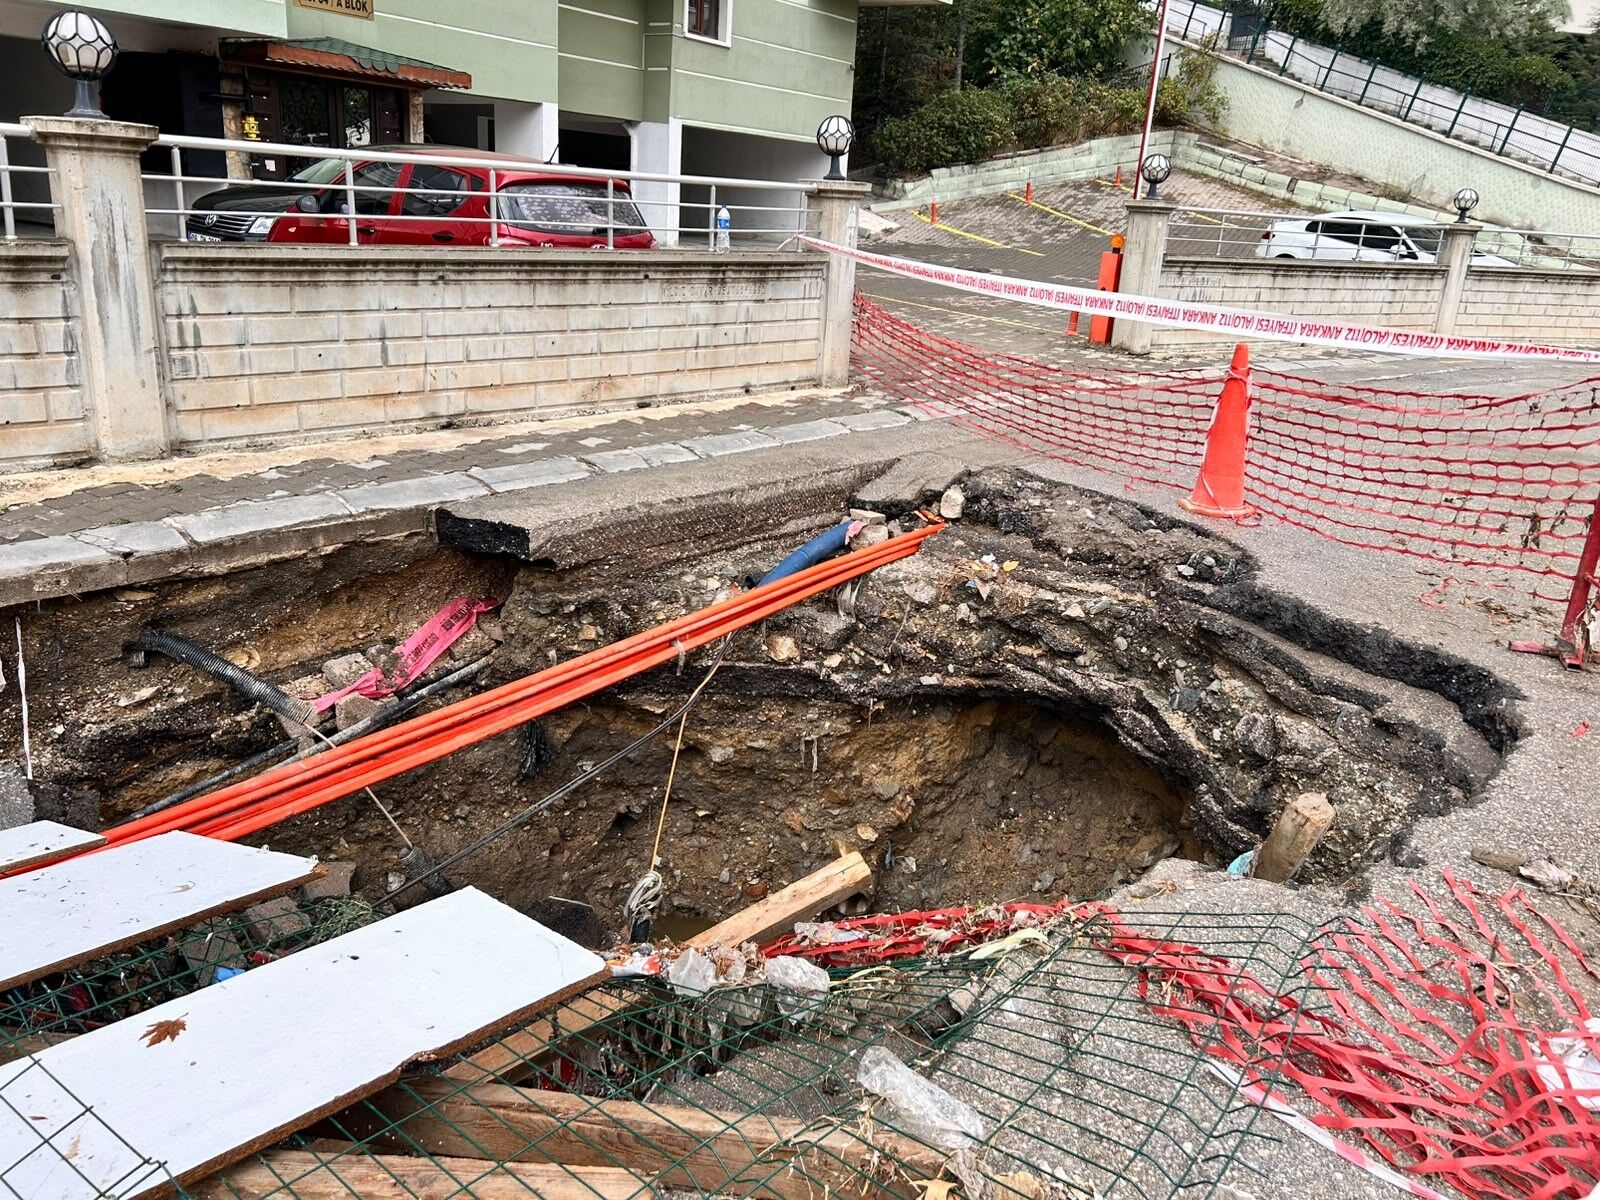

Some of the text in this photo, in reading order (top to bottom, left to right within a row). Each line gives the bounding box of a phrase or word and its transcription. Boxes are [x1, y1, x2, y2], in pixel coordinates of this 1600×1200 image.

[336, 0, 343, 8] A
[345, 0, 368, 13] BLOK
[1004, 282, 1029, 296] ANKARA
[1055, 291, 1083, 308] İTFAİYESİ
[1085, 295, 1113, 310] ANKARA
[1116, 299, 1145, 314] (ALO)112
[1145, 303, 1181, 322] İTFAİYESİ
[1182, 308, 1217, 324] ANKARA
[1219, 313, 1254, 329] (ALO)112
[1254, 318, 1297, 337] İTFAİYESİ
[1300, 322, 1343, 339] ANKARA
[1344, 327, 1389, 344] (ALO)112
[1389, 332, 1443, 351] İTFAİYESİ
[1445, 337, 1500, 352] ANKARA
